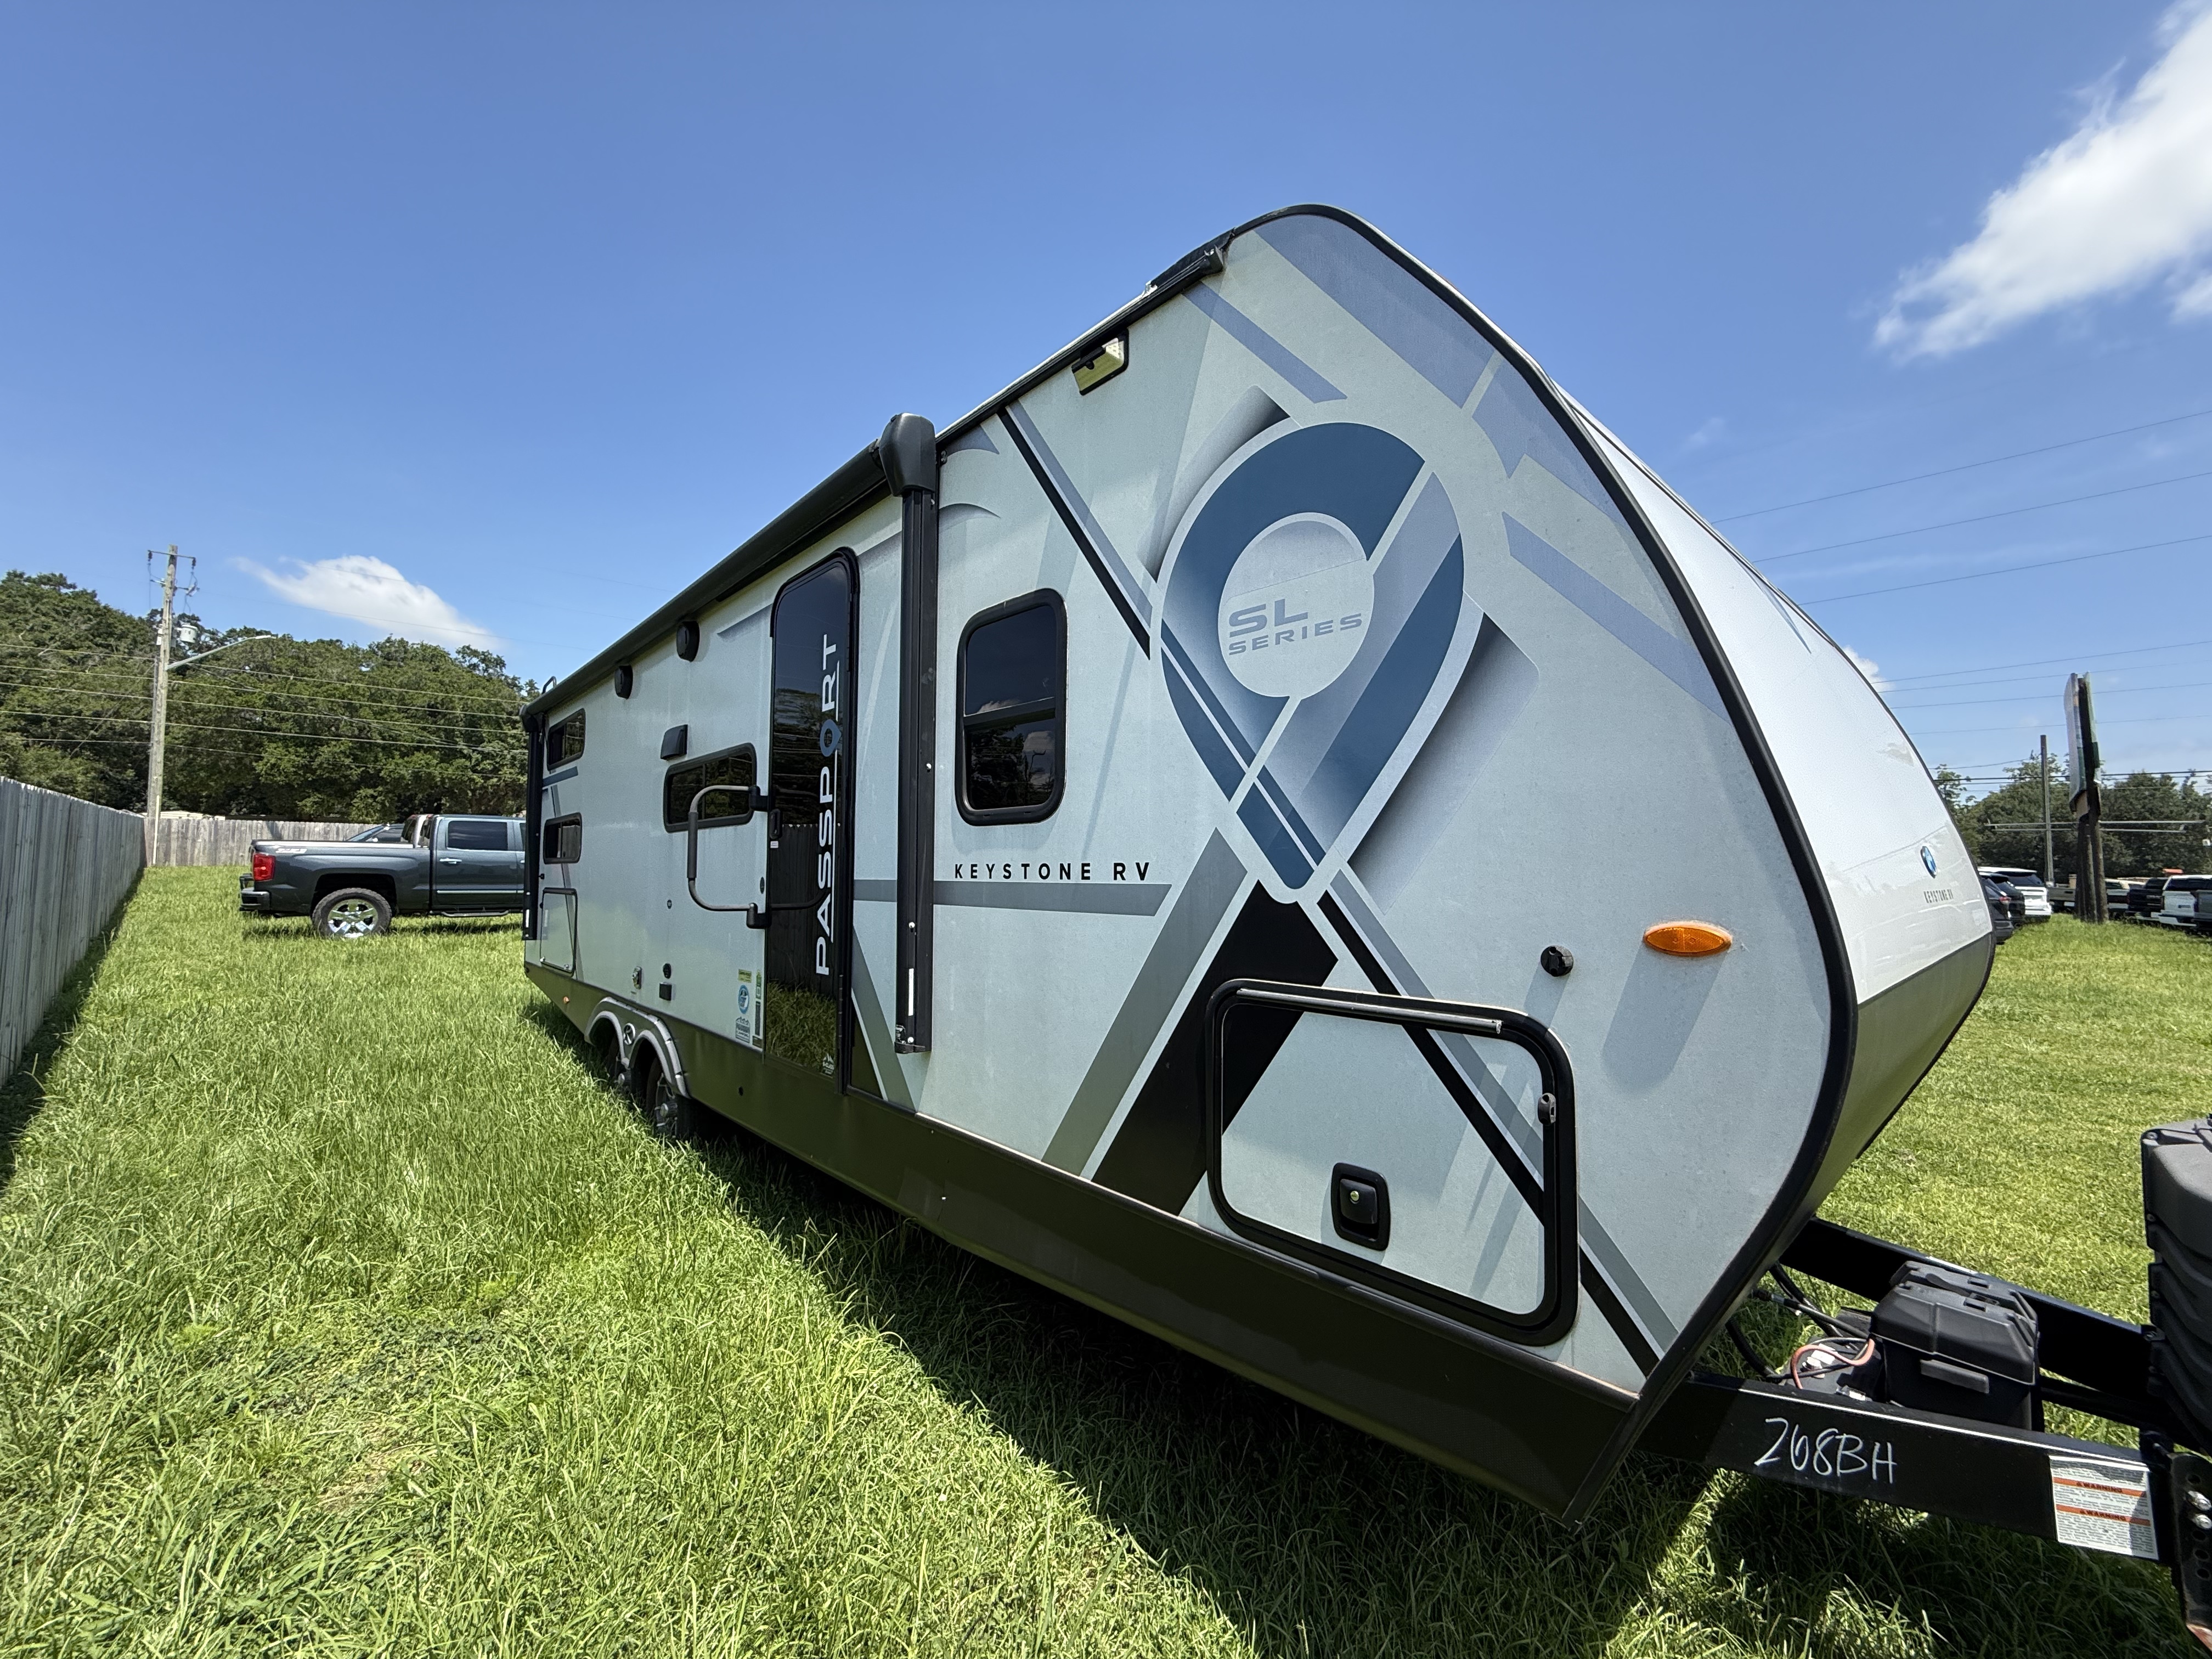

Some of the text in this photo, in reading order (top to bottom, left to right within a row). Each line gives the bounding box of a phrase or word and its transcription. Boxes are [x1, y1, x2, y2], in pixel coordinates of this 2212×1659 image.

[1229, 599, 1308, 637] SL
[1229, 613, 1362, 655] SERIES
[816, 634, 841, 975] PASSPORT
[955, 862, 1150, 881] KEYSTONE RV
[1754, 1418, 1897, 1483] 268BH
[2086, 1510, 2126, 1521] WARNING
